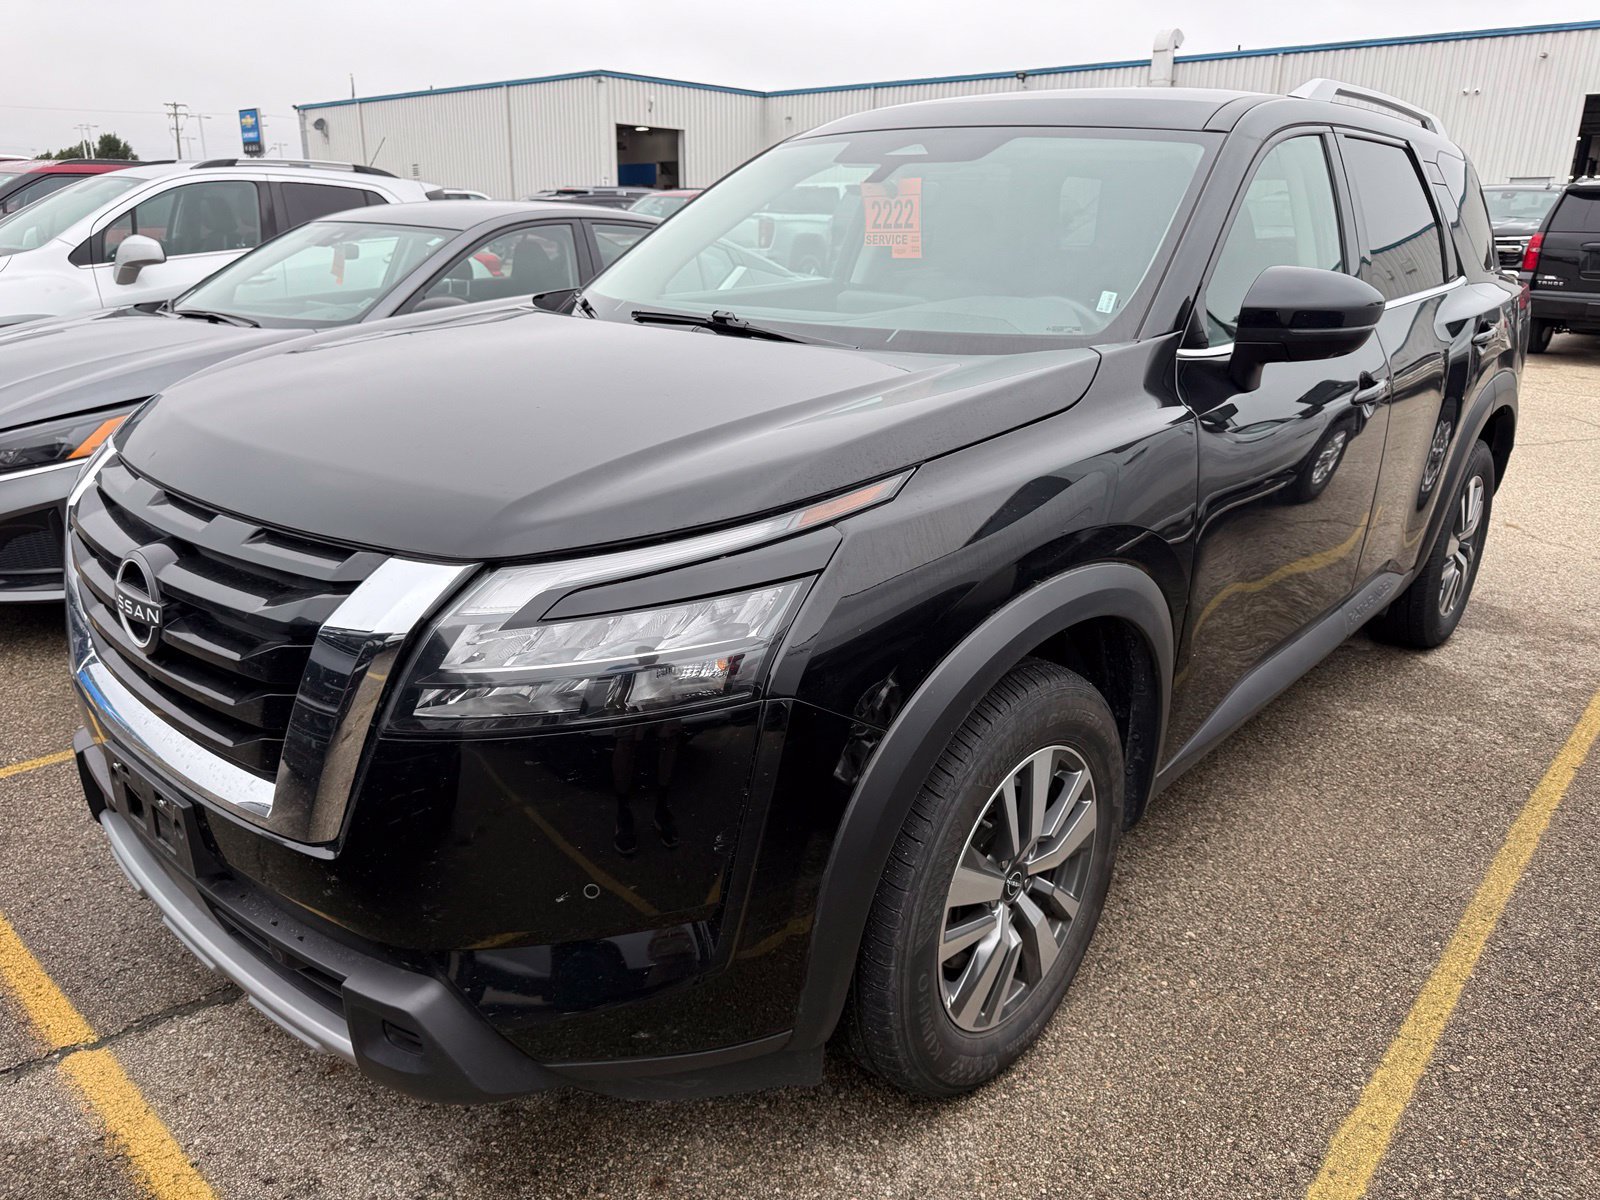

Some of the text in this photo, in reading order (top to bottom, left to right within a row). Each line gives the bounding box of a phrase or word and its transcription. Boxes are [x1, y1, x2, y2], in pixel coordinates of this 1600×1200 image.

[871, 199, 914, 229] 2222
[865, 234, 908, 245] SERVICE
[118, 594, 159, 624] SSAN
